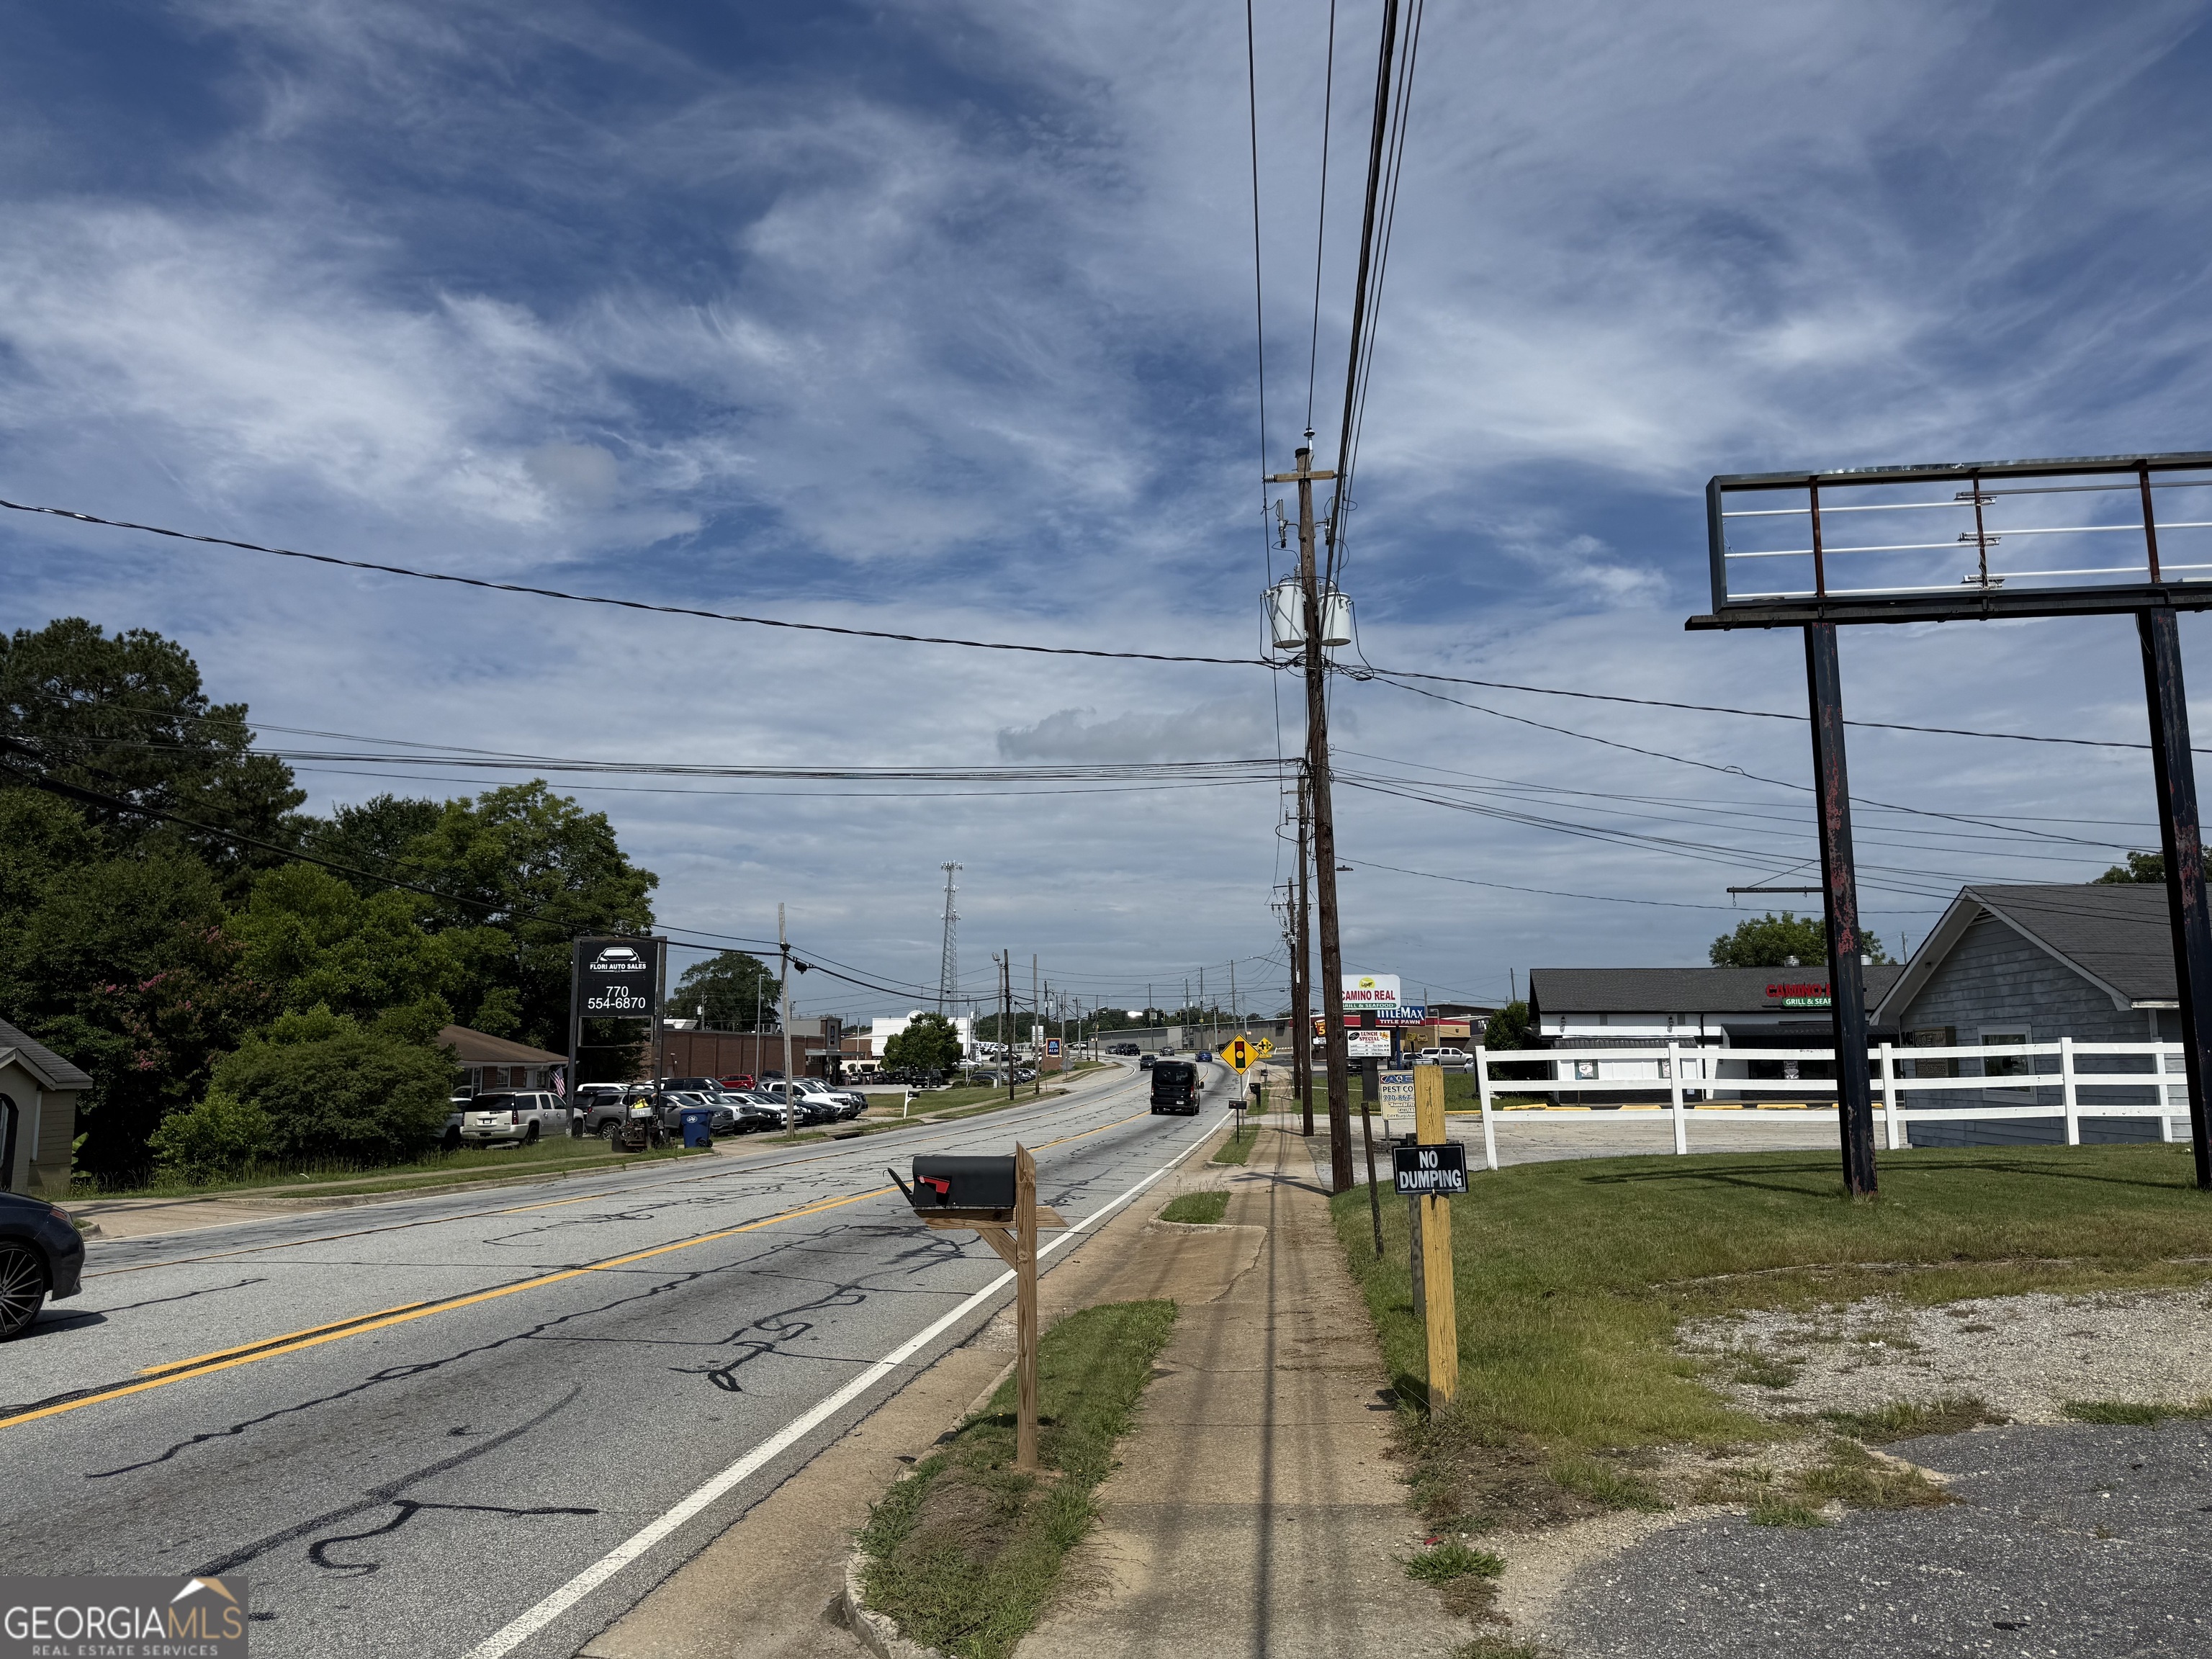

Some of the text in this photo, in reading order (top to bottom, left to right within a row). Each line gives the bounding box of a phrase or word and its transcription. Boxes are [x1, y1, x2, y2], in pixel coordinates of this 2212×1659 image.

[606, 986, 629, 997] 770
[1342, 990, 1395, 1000] CAMINO REAL
[1766, 984, 1822, 998] CAMINO
[588, 997, 646, 1009] 554-6870
[1318, 1025, 1326, 1035] 5
[1419, 1151, 1438, 1168] NO
[1399, 1169, 1462, 1188] DUMPING
